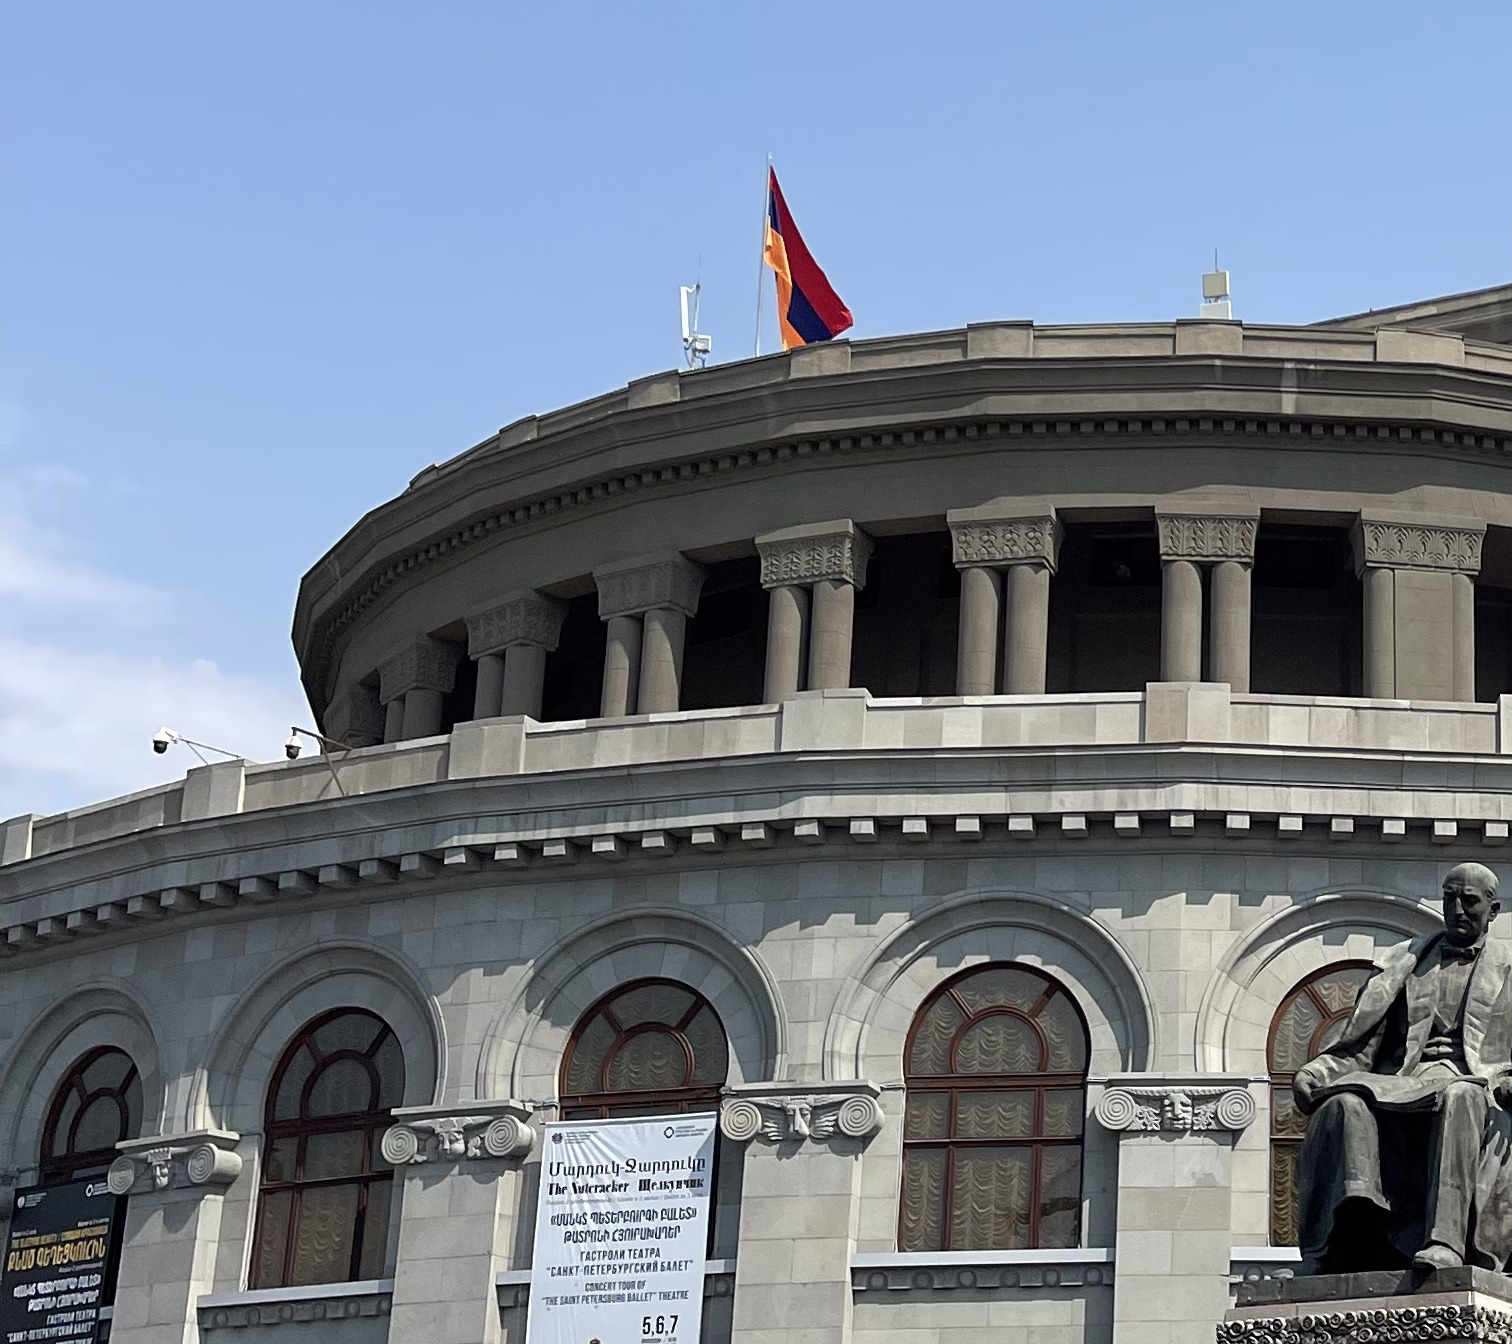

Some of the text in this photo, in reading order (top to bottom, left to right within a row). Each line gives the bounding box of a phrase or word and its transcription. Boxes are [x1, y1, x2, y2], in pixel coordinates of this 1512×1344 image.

[548, 1182, 568, 1195] The
[580, 1247, 661, 1262] ГАСТРОЛИ ТЕАТРА
[584, 1280, 646, 1292] CONCERT TOUR OF
[560, 1295, 580, 1305] SAINT
[659, 1290, 689, 1302] THEATRE
[642, 1315, 678, 1337] 5,6,7
